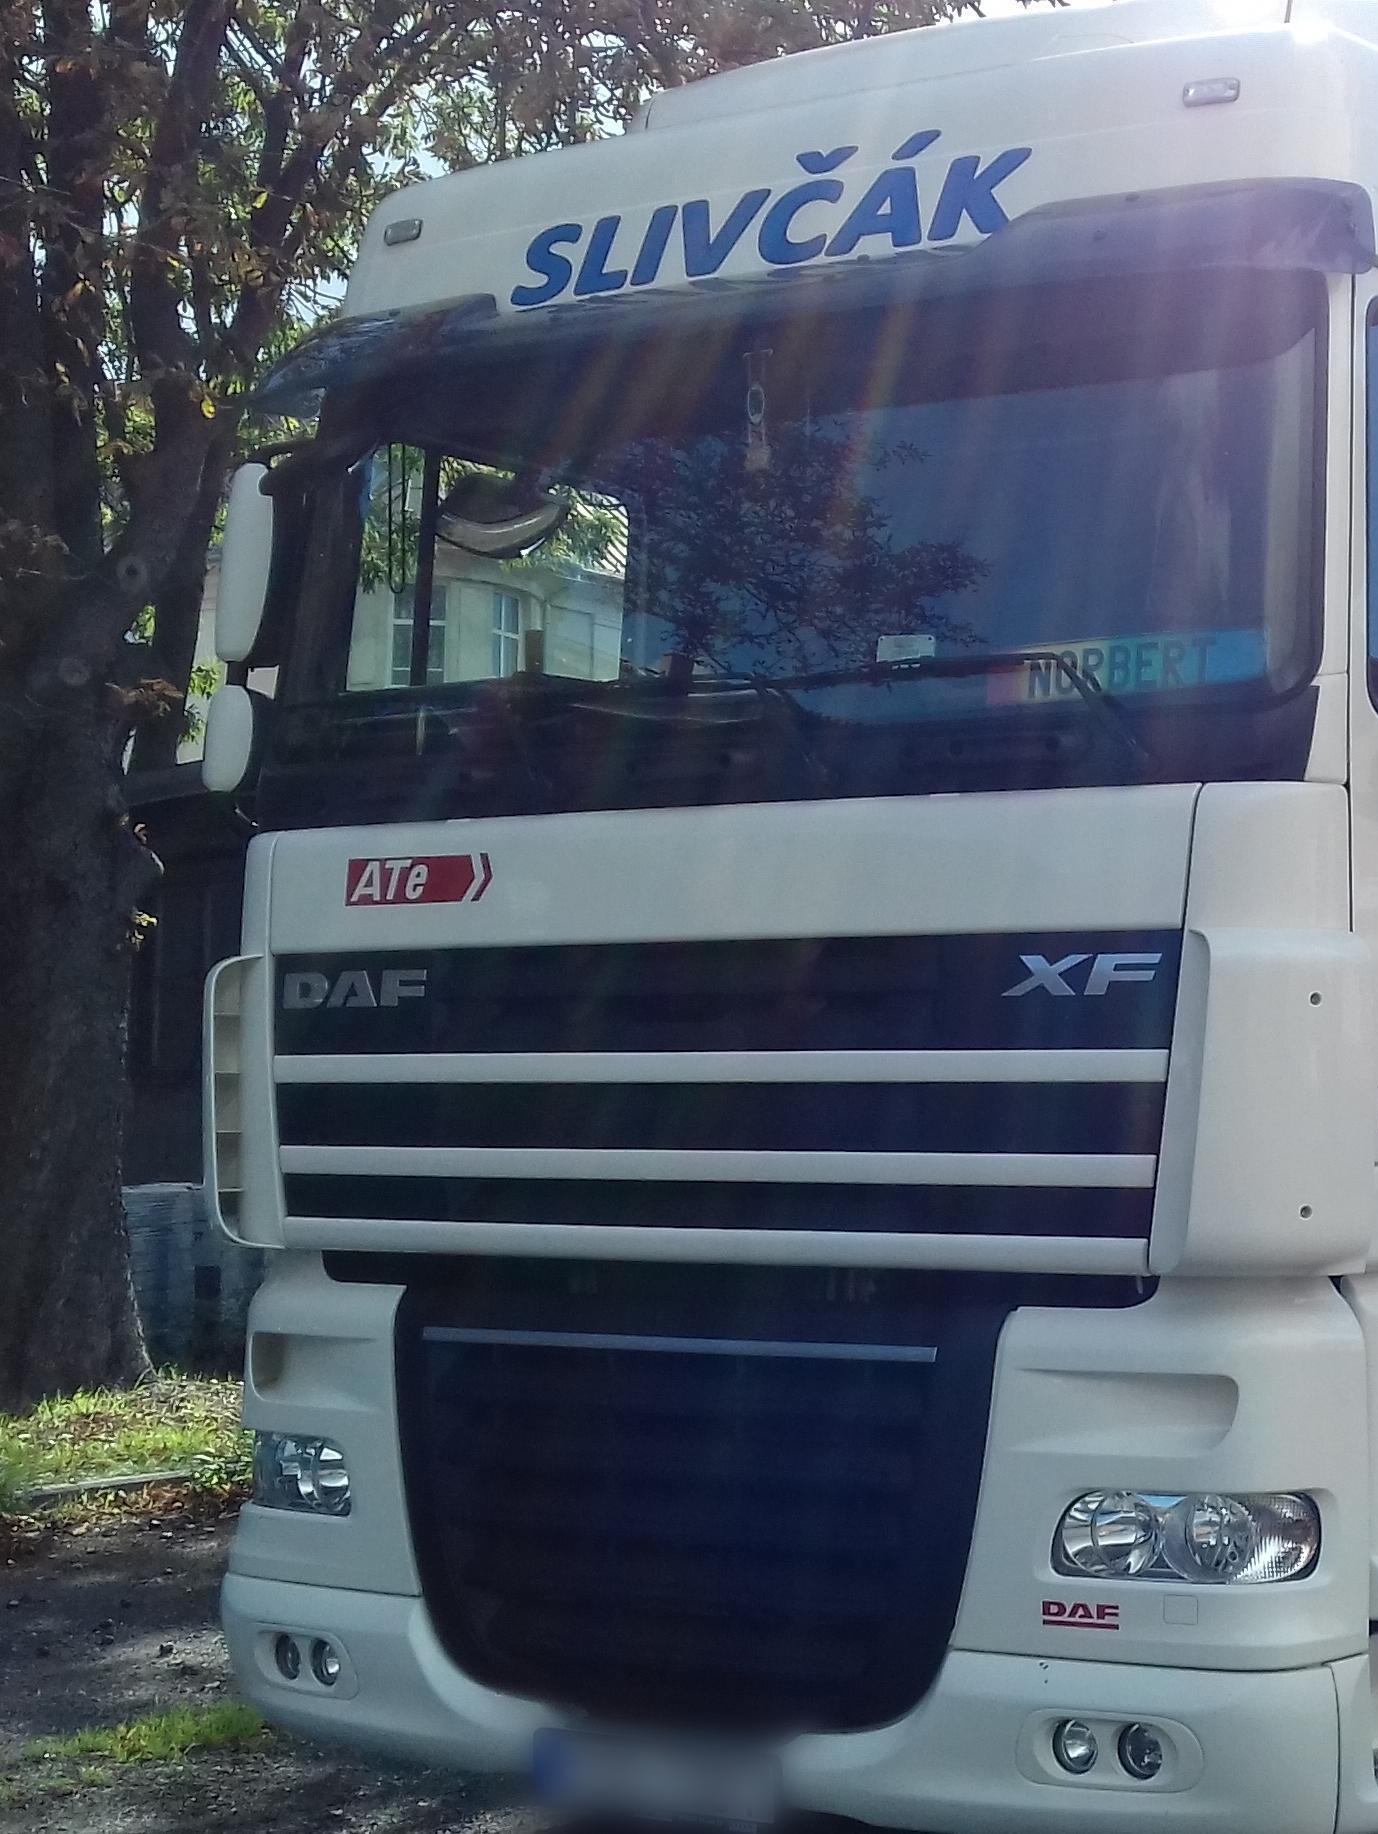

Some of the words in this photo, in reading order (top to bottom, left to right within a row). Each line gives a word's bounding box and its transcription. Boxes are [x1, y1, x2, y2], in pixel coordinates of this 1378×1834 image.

[510, 129, 1032, 307] SLIVČÁK
[1024, 636, 1216, 699] NORBERT
[350, 859, 428, 902] ATe
[283, 968, 427, 1009] DAF
[1001, 953, 1162, 997] XF
[1042, 1600, 1119, 1620] DAF
